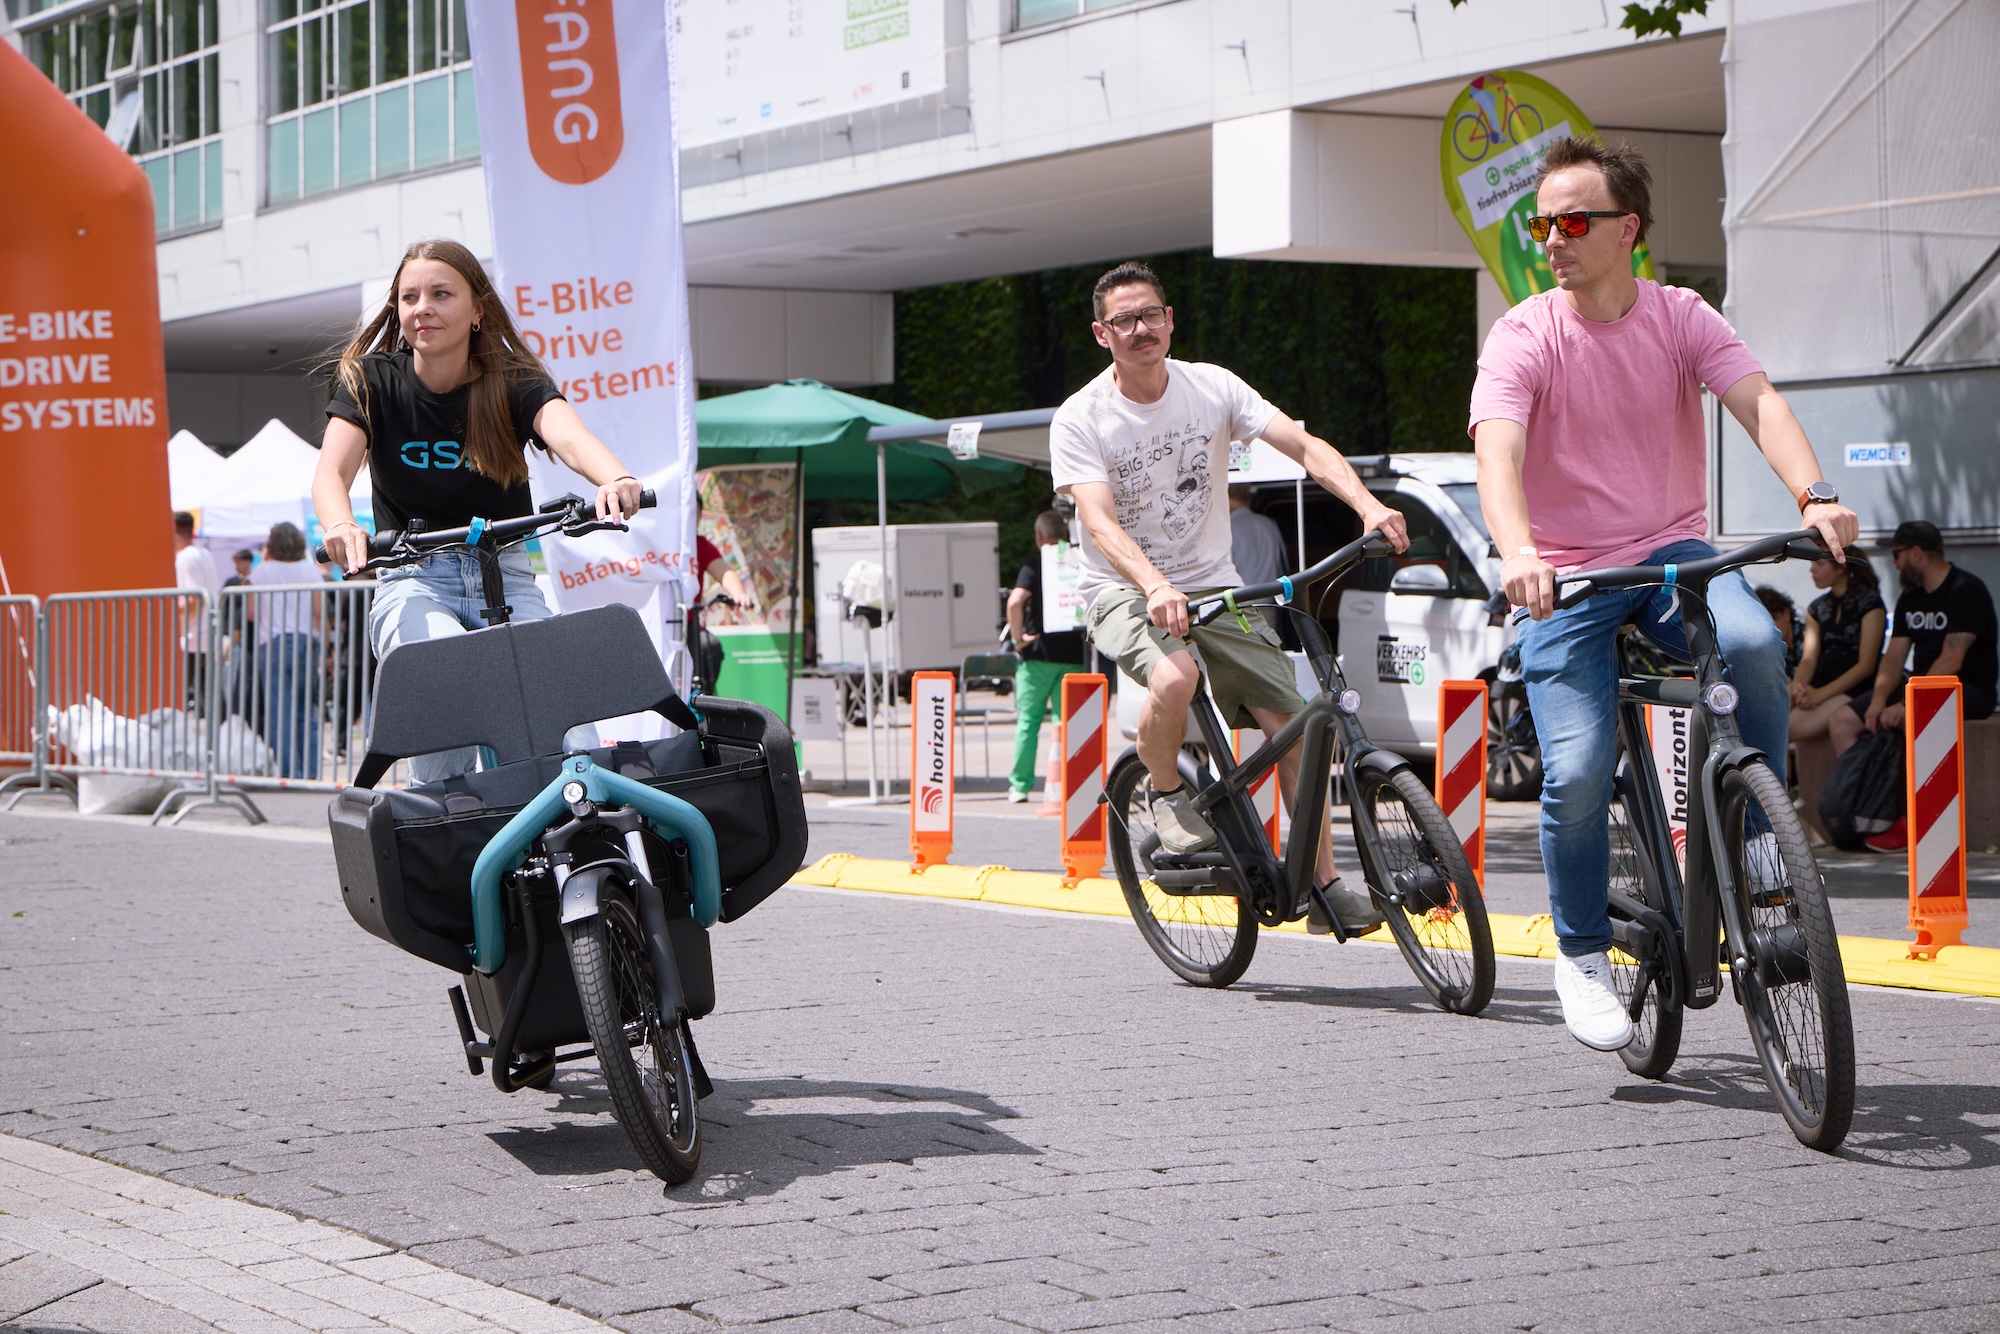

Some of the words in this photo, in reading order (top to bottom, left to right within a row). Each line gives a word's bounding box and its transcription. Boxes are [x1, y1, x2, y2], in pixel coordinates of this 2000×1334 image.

[544, 0, 598, 144] ANG
[515, 276, 633, 316] E-Bike
[0, 310, 113, 343] E-BIKE
[521, 325, 623, 360] Drive
[0, 354, 111, 388] DRIVE
[1, 398, 155, 431] SYSTEMS
[400, 441, 471, 469] GS
[1117, 456, 1143, 479] BIG
[1145, 442, 1173, 468] BOYS
[1377, 643, 1426, 661] VERKEHRS
[1378, 660, 1410, 676] WACHT
[928, 695, 944, 784] horizont
[1666, 708, 1688, 823] horizont
